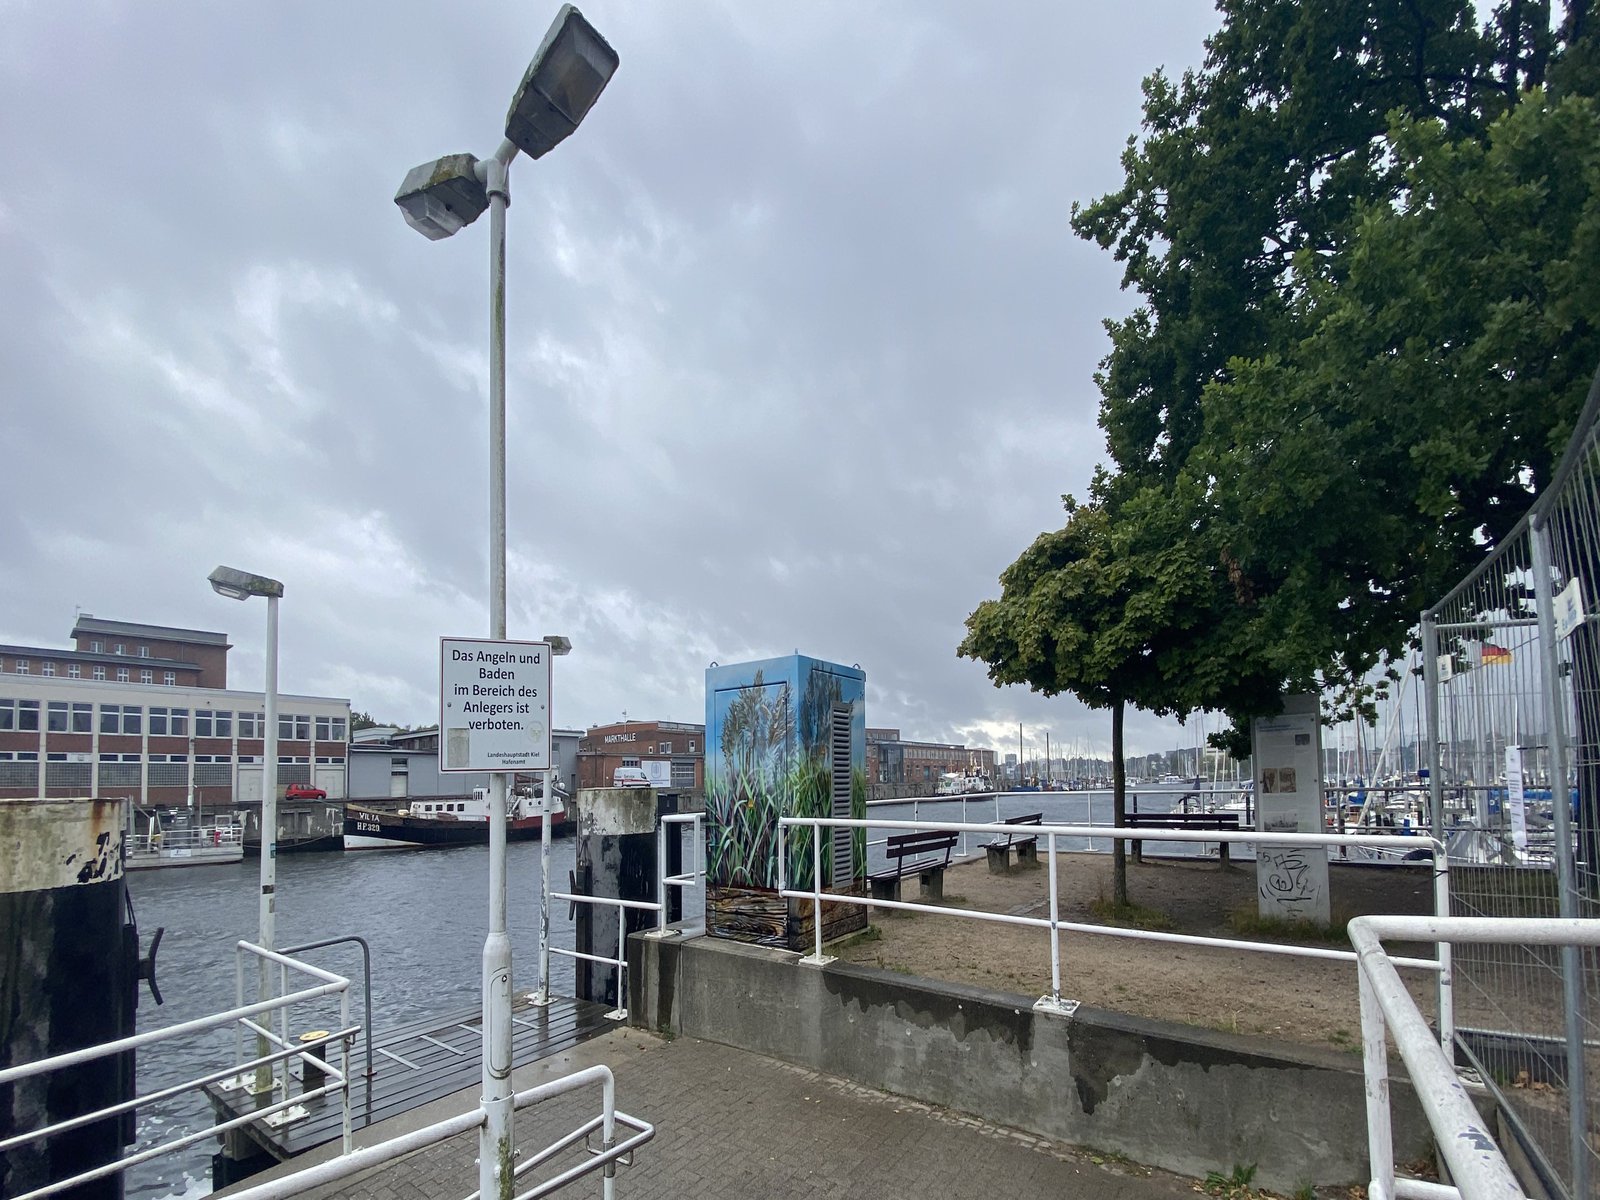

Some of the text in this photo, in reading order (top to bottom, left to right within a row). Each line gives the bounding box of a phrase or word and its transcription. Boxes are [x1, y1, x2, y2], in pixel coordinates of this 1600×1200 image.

[452, 649, 541, 665] Das Angeln und
[479, 667, 515, 680] Baden
[454, 683, 537, 698] im Bereich des
[463, 701, 530, 716] Anlegers ist
[468, 718, 524, 731] verboten.
[604, 733, 636, 744] MARKTHALLE
